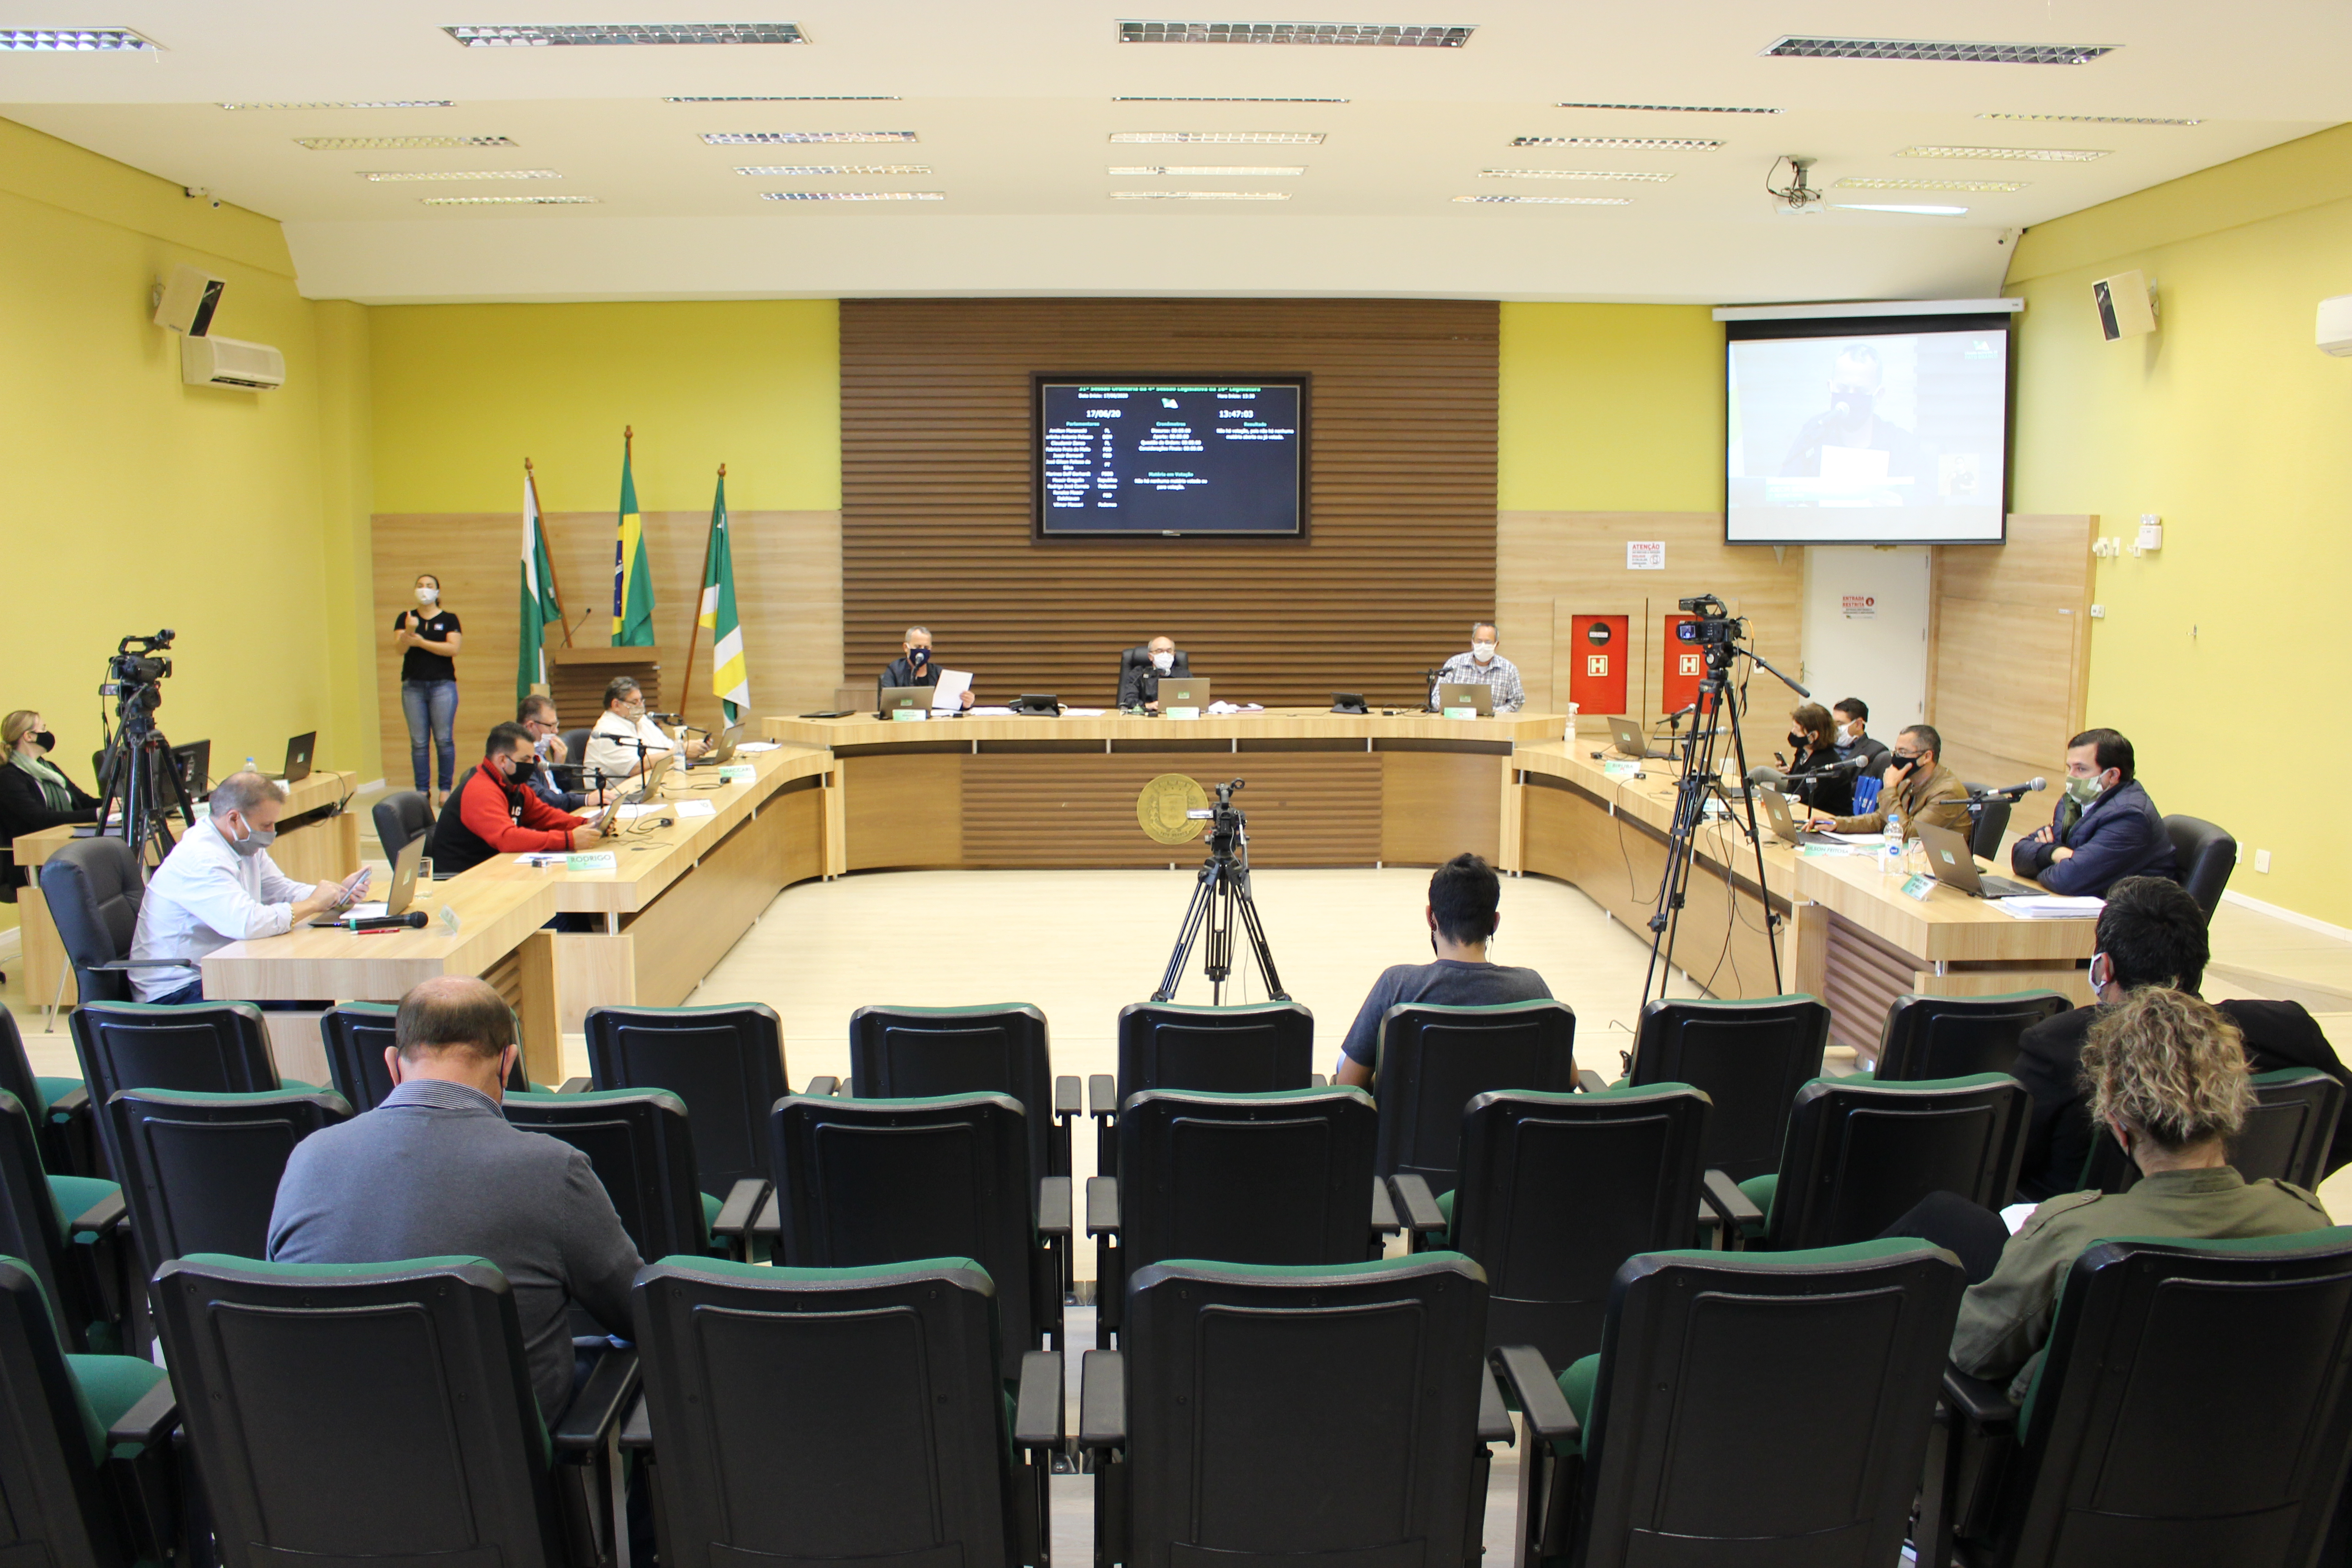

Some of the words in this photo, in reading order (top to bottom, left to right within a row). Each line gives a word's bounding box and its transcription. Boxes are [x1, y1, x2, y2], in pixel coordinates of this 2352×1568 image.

[1086, 410, 1122, 418] 17/06/20
[1219, 410, 1254, 418] 13:47:03
[1591, 658, 1605, 673] H
[1682, 658, 1696, 672] H
[570, 854, 611, 863] RODRIGO
